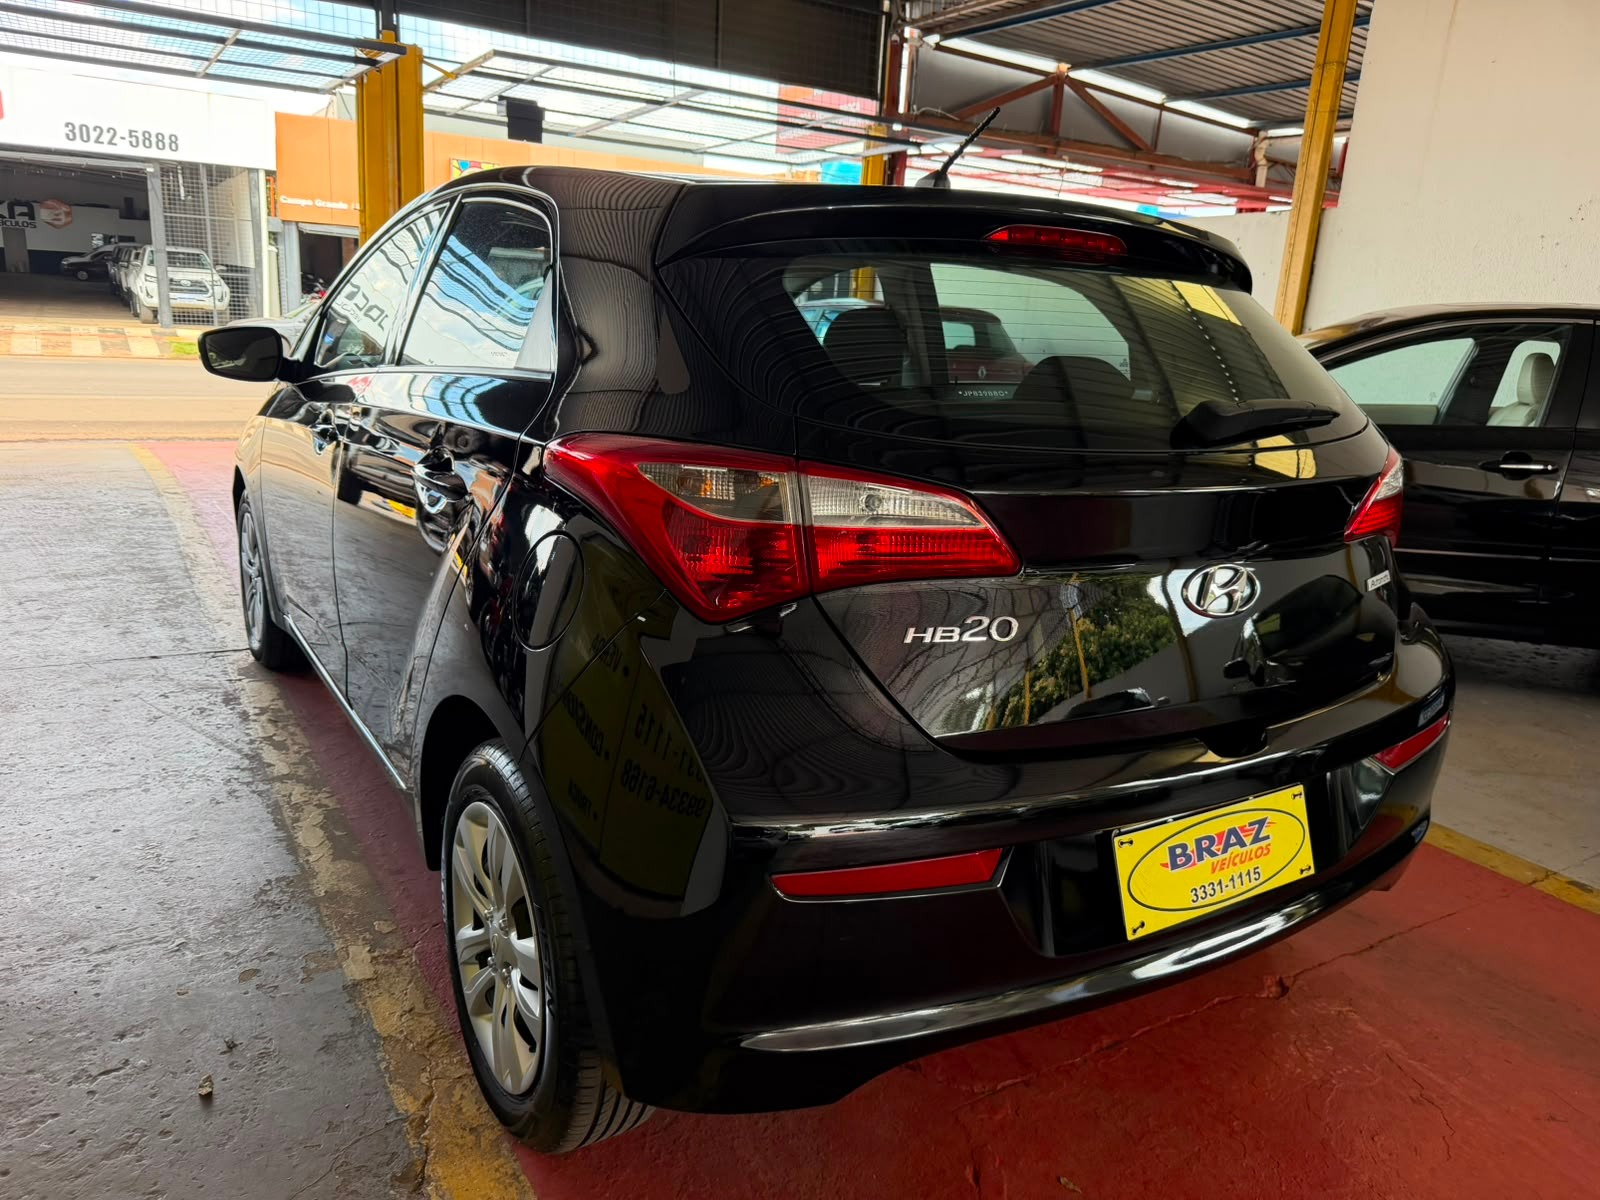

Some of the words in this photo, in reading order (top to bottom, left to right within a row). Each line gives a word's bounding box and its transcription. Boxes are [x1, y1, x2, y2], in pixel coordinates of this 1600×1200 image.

[65, 121, 179, 152] 3022-5888
[904, 615, 1019, 644] HB20
[1167, 816, 1271, 872] BRAZ
[1210, 843, 1271, 874] VEÍCULOS
[1190, 866, 1262, 904] 3331-1115
